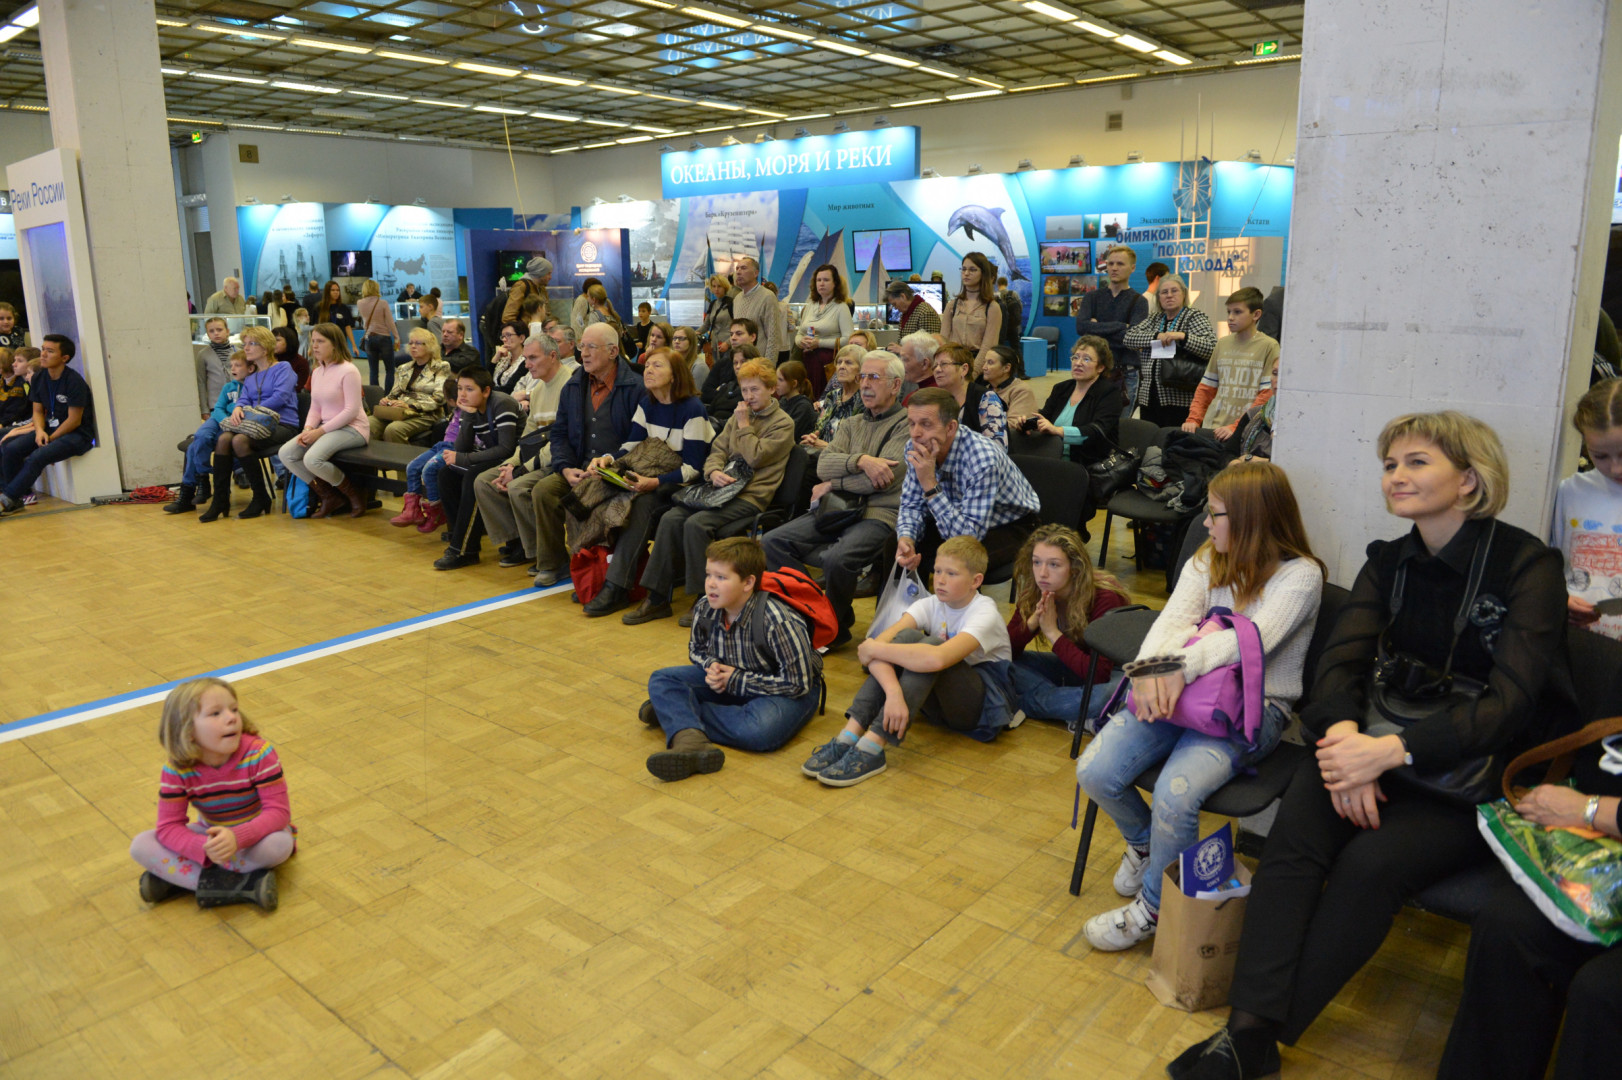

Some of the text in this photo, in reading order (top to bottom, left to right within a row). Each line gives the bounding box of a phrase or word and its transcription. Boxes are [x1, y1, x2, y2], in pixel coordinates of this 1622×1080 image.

[670, 145, 893, 185] ОКЕАНЫ, МОРЯ И РЕКИ
[10, 181, 66, 212] Реки России
[827, 202, 875, 212] Мир животных
[1115, 227, 1176, 243] ОЙМЯКОН
